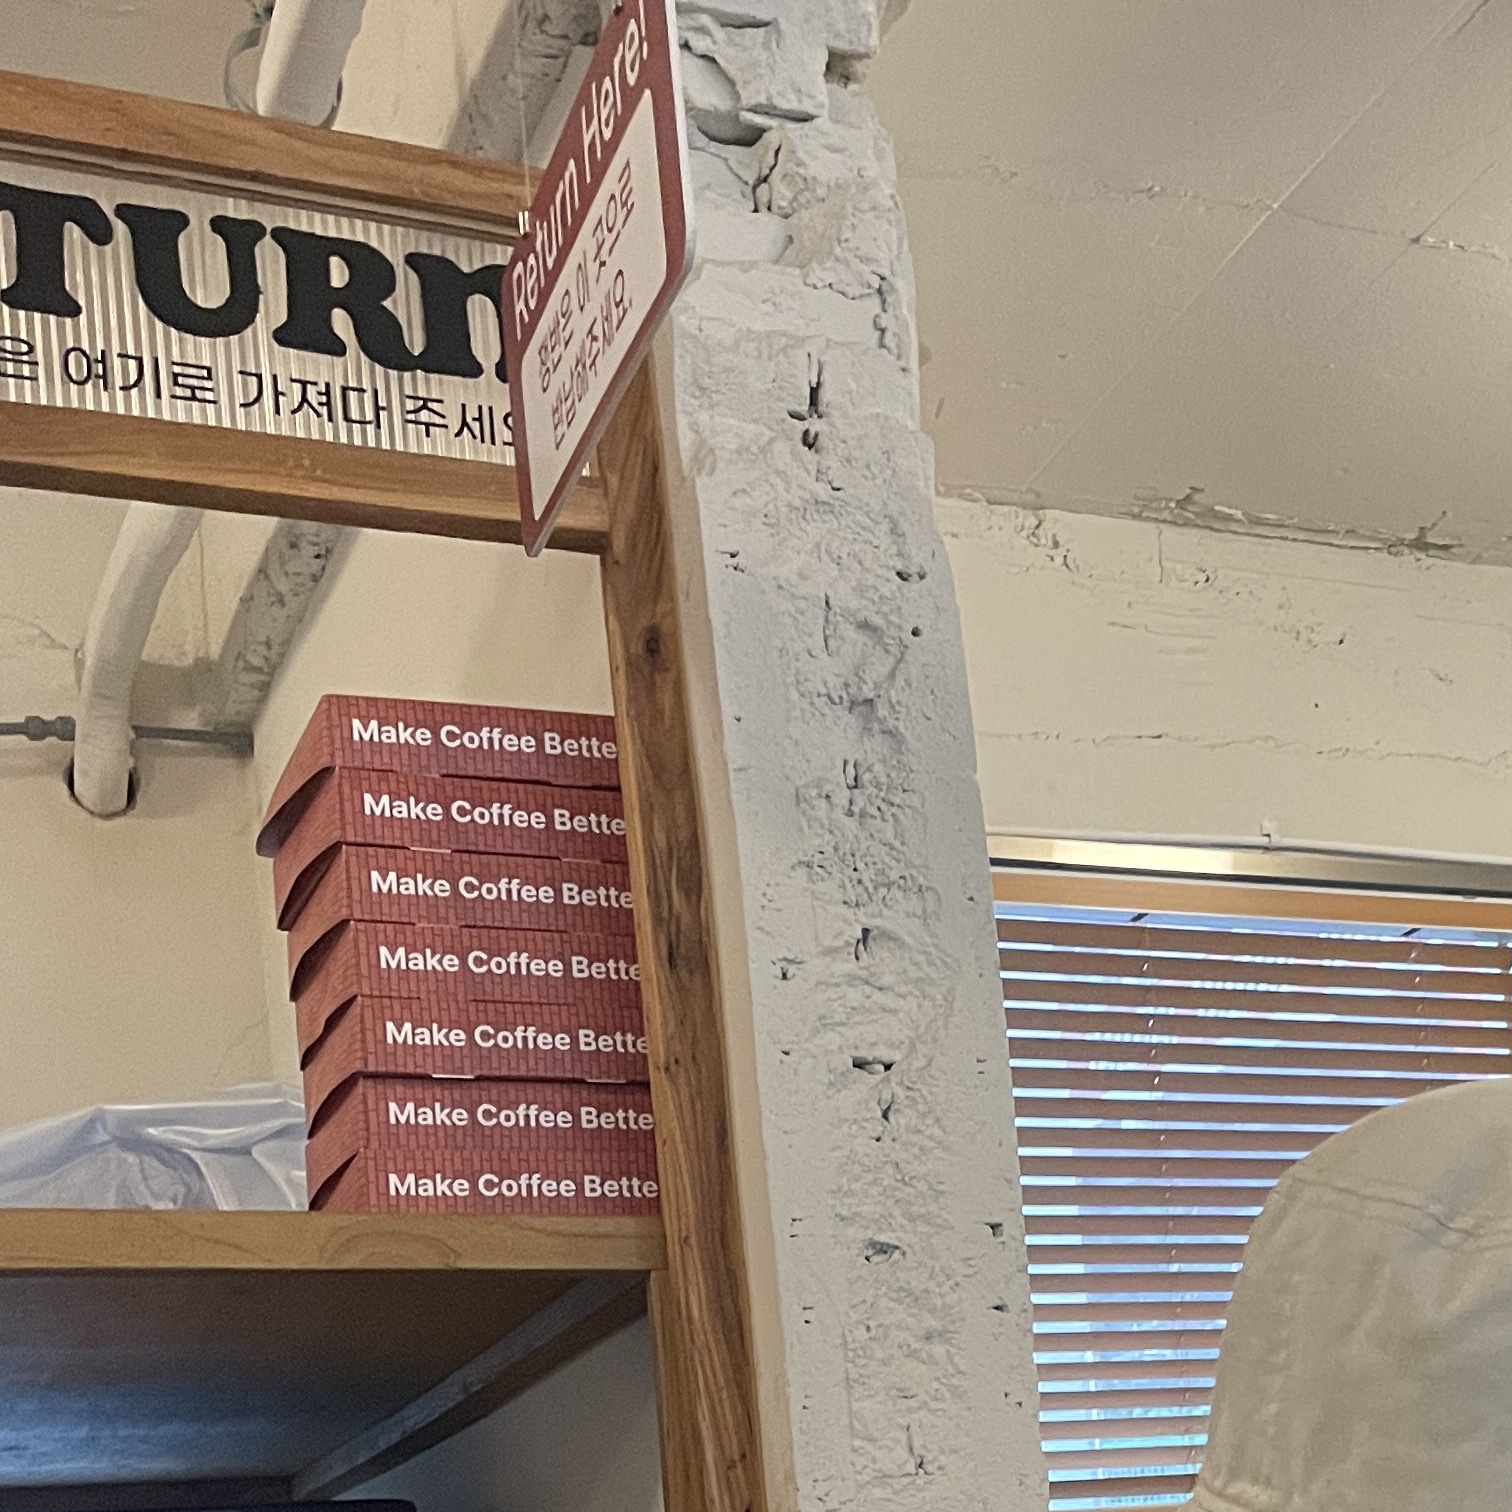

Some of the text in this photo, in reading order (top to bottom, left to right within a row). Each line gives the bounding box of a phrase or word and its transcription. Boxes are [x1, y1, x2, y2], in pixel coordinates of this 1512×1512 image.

[512, 0, 648, 342] Return Here!
[576, 250, 590, 314] 이
[592, 158, 635, 285] 곳으로
[63, 346, 219, 405] 여기로
[238, 368, 386, 431] 가져다
[352, 719, 617, 759] Make Coffee Bette
[363, 793, 626, 836] Make Coffee Bette
[370, 870, 633, 909] Make Coffee Bette
[378, 945, 641, 981] Make Coffee Bette
[385, 1021, 648, 1054] Make Coffee Bette
[388, 1101, 654, 1130] Make Coffee Bette
[388, 1173, 659, 1198] Make Coffee Bette
